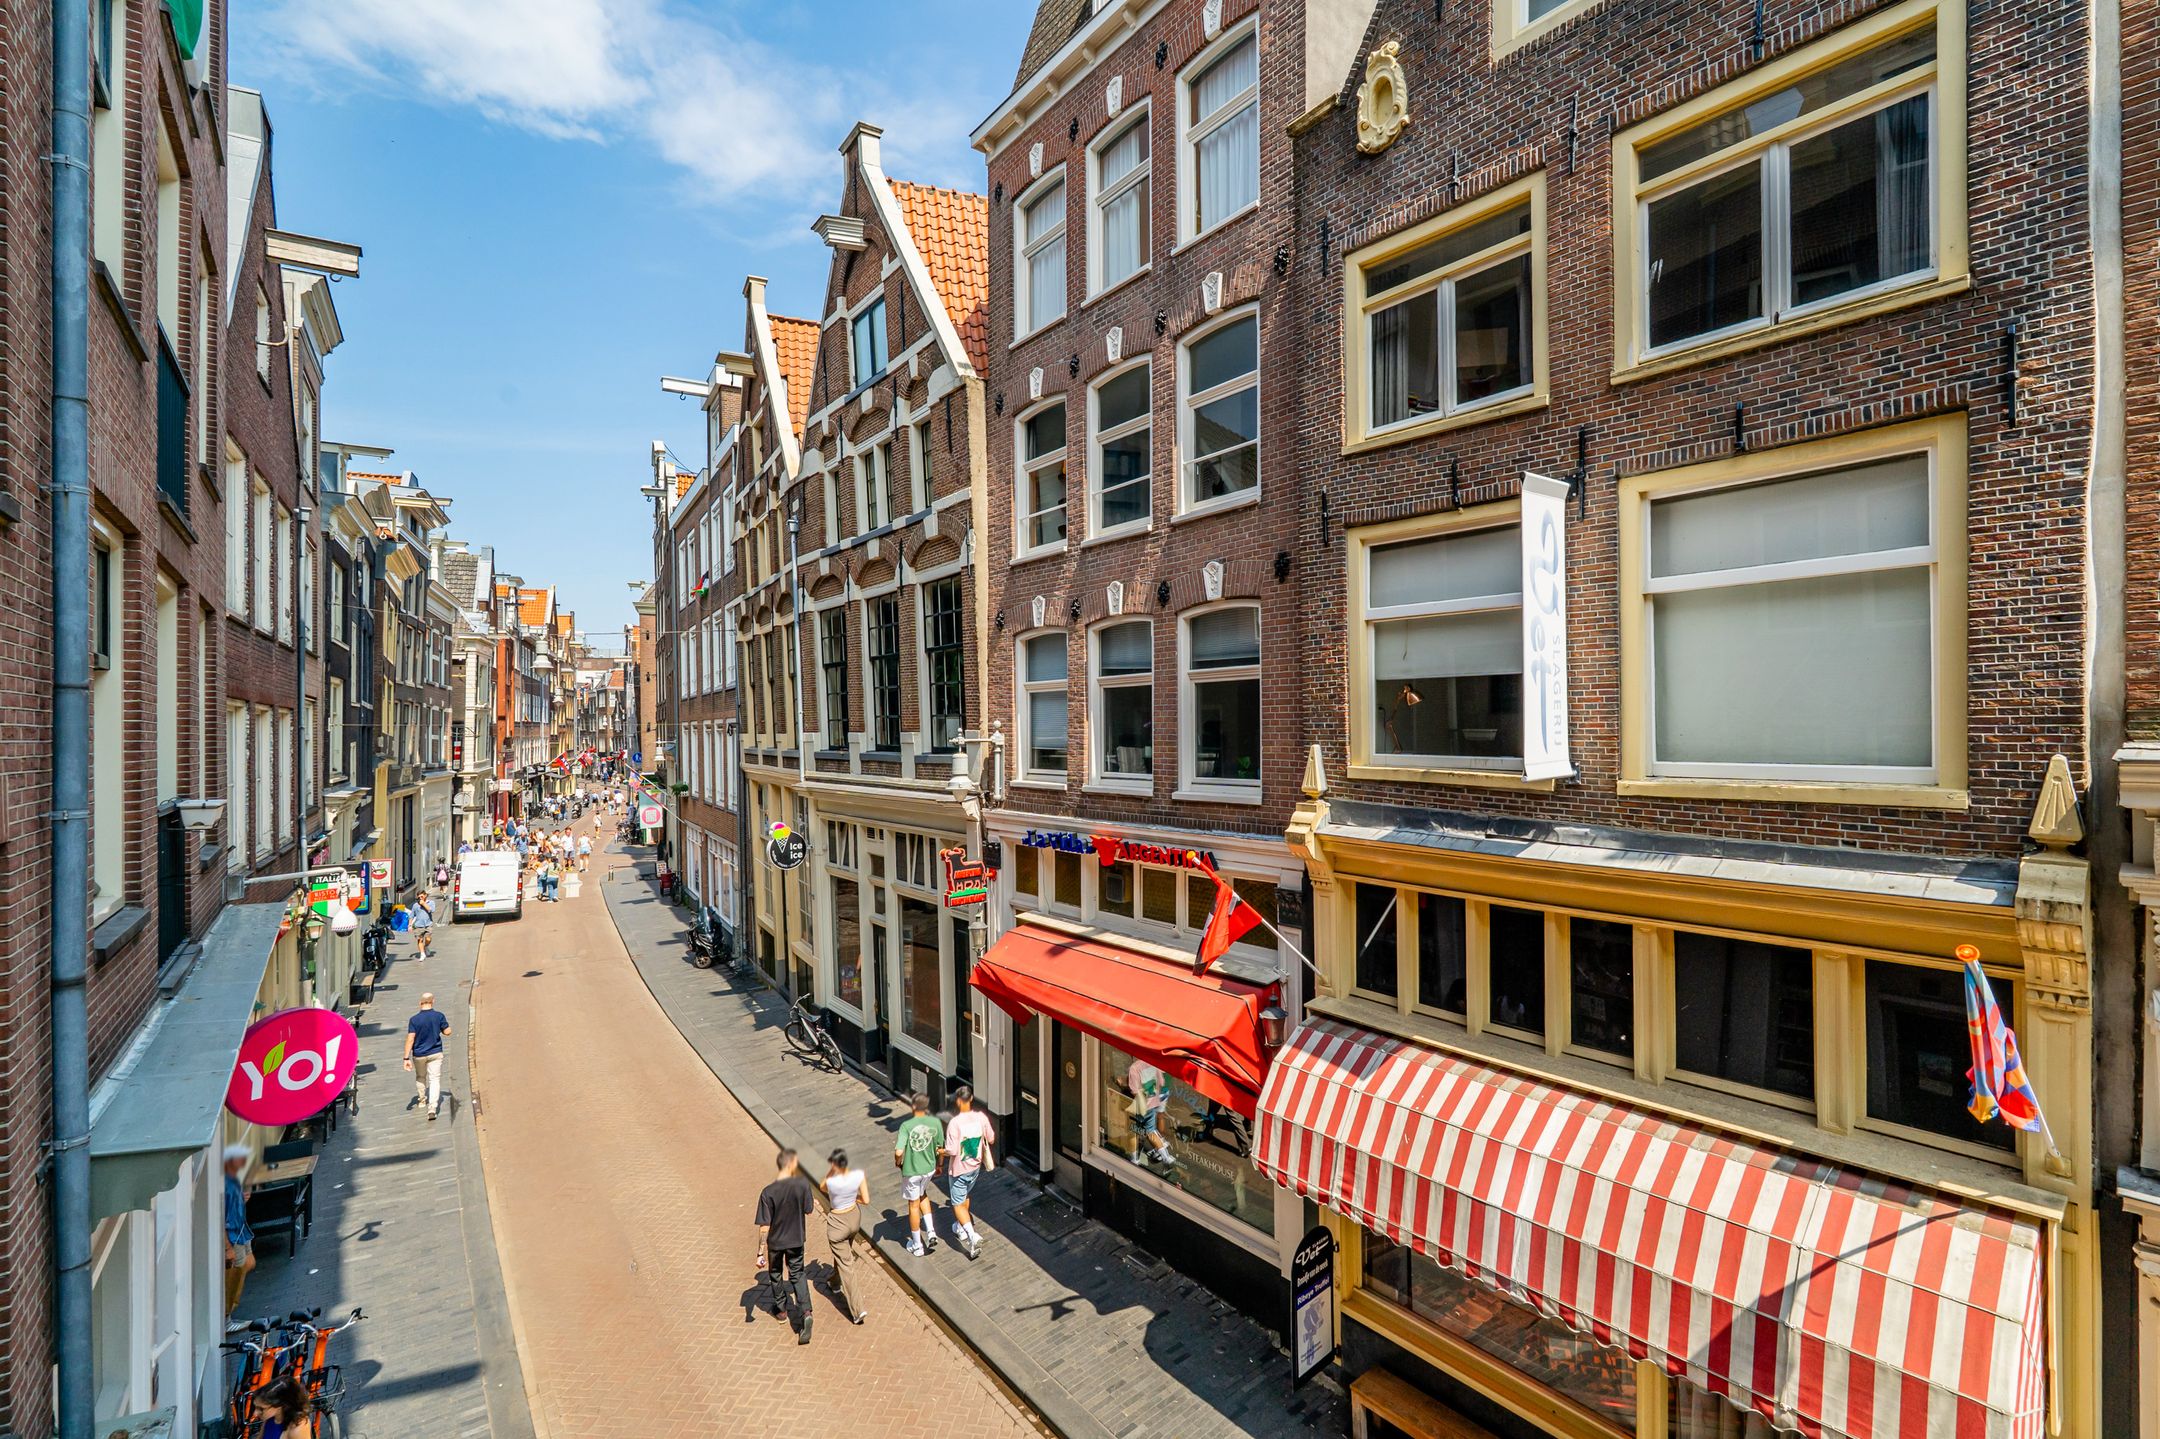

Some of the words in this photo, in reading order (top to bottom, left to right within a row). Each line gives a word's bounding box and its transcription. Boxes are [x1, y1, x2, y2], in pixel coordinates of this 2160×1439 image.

[1552, 634, 1562, 747] SLAGERIJ
[789, 842, 803, 850] Ice
[790, 851, 803, 860] ice
[240, 1034, 342, 1101] YO!
[1187, 1151, 1235, 1181] STEAKHOUSE
[1295, 1240, 1329, 1266] Vet
